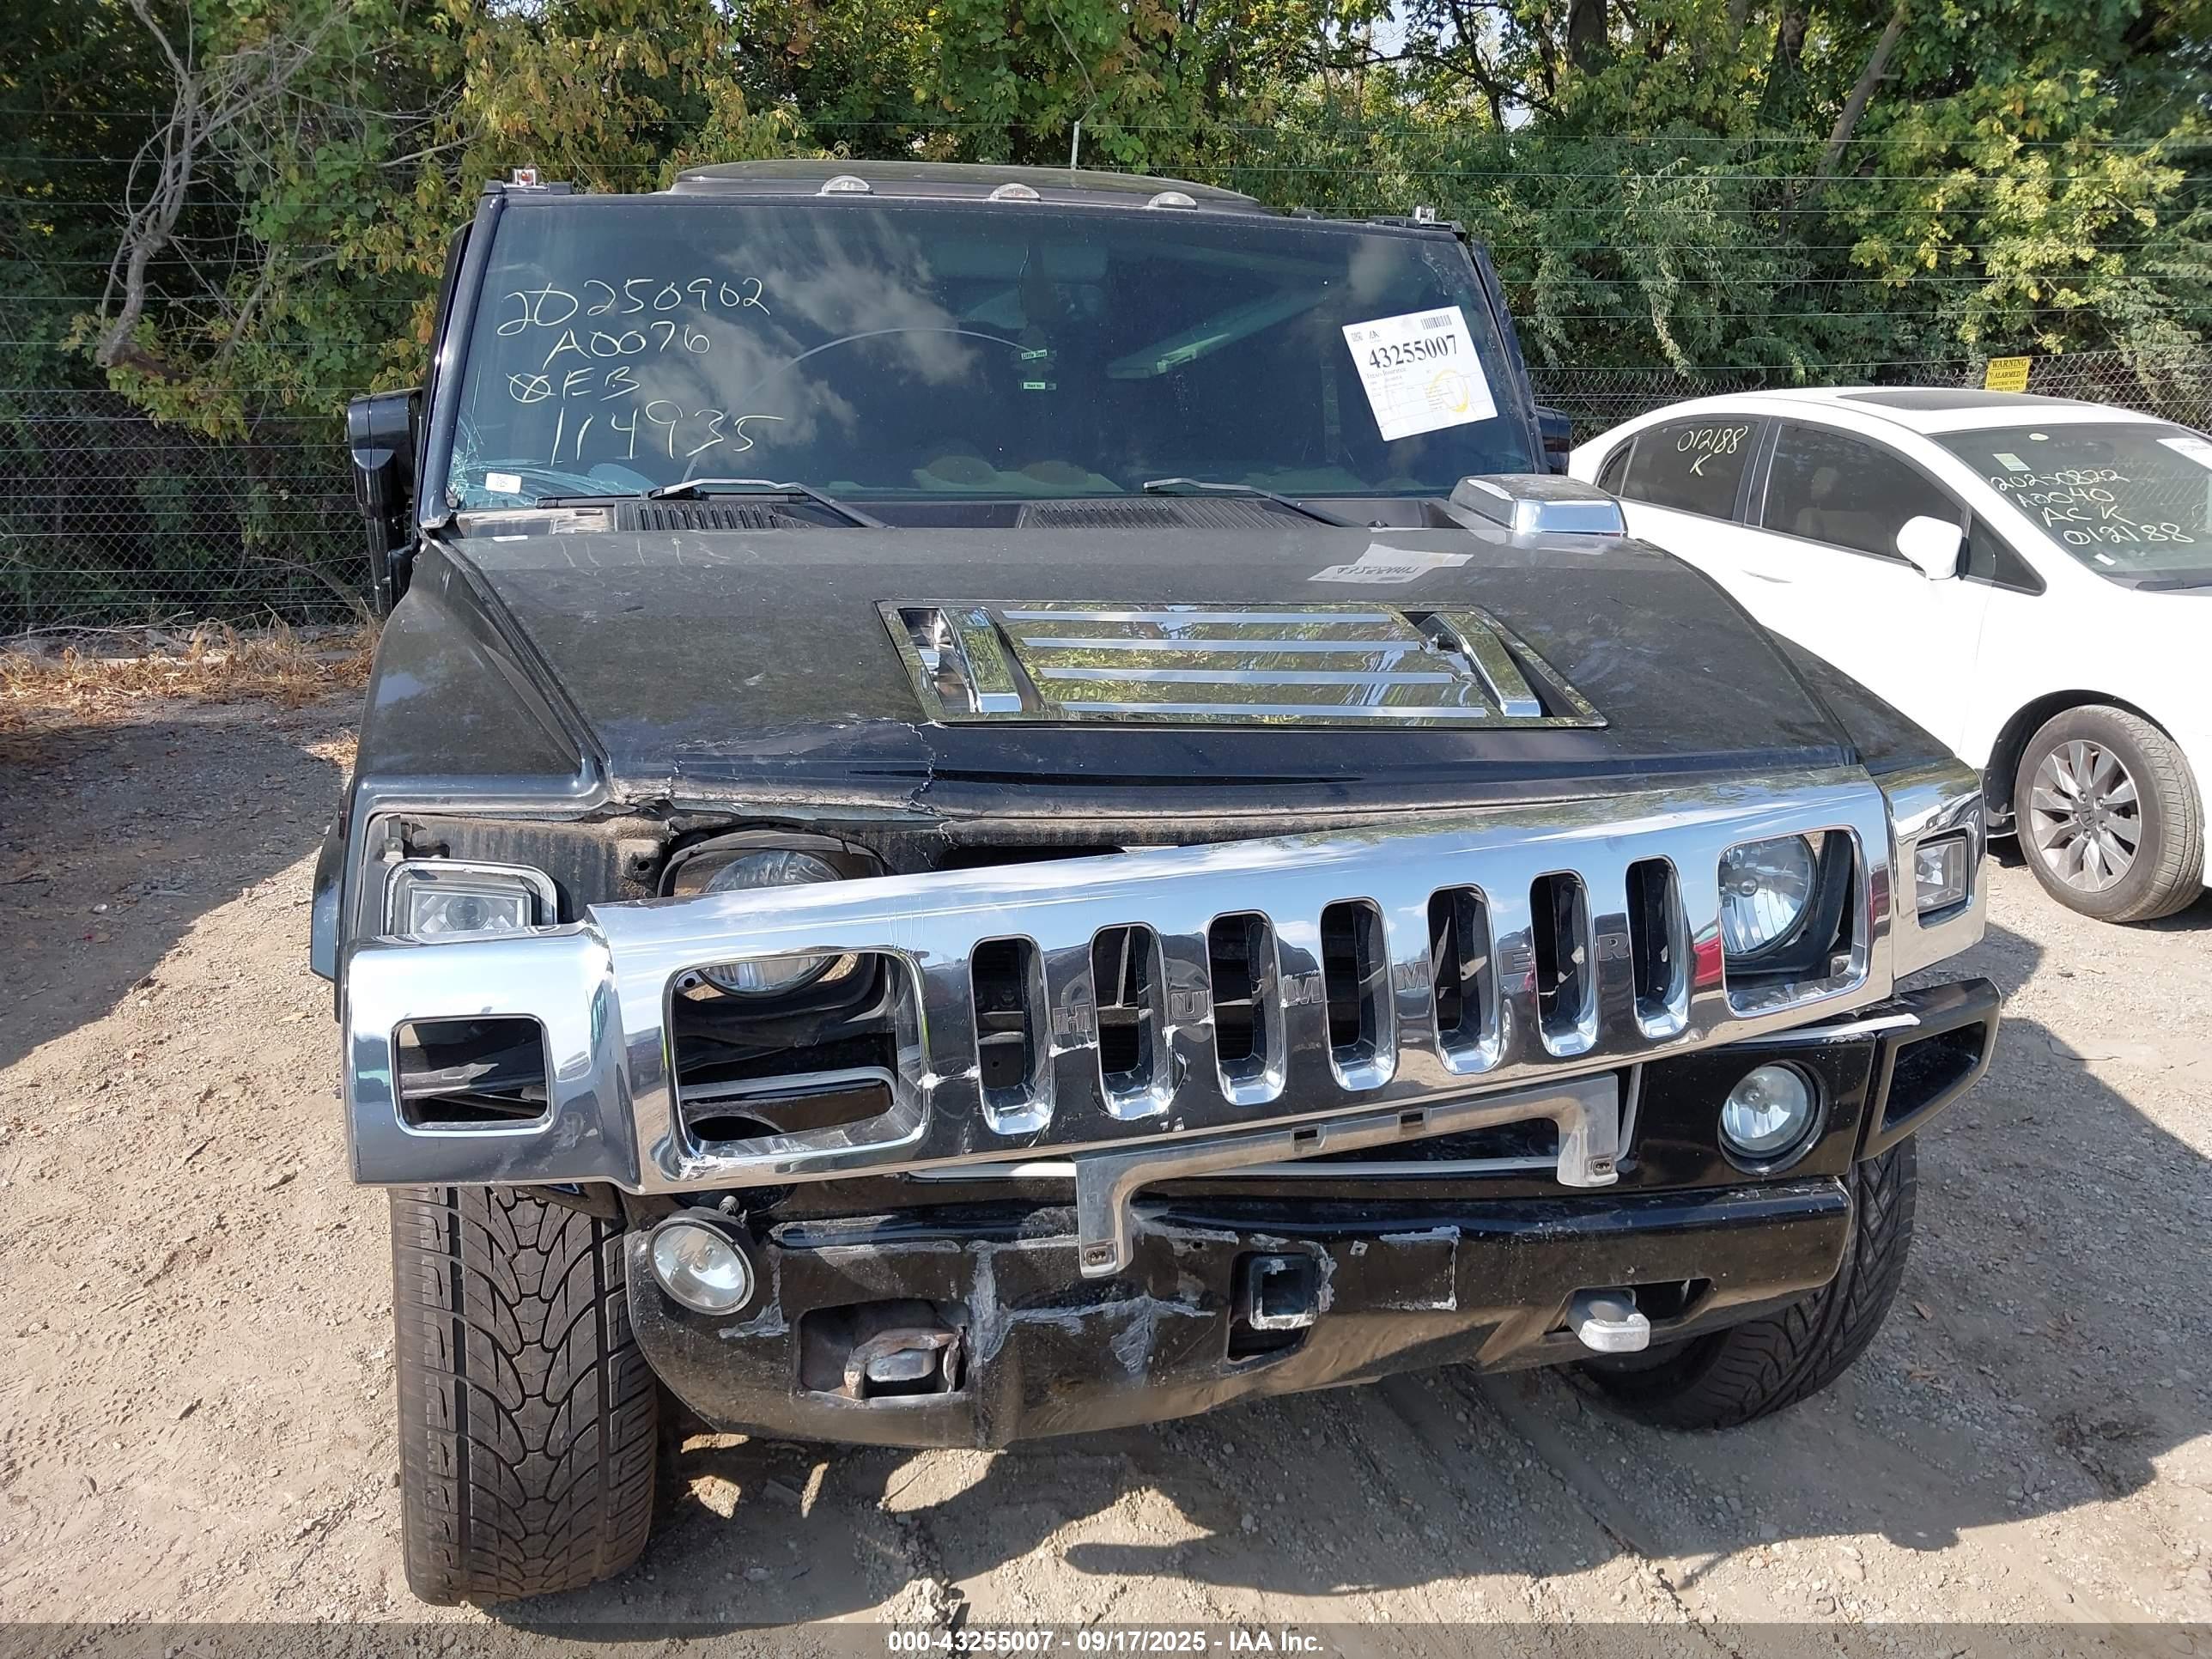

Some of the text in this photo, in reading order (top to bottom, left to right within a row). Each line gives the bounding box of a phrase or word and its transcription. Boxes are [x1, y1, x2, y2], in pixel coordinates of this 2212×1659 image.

[543, 320, 710, 371] A0076
[1369, 334, 1457, 369] 43255007
[1991, 358, 2027, 368] WARNING
[1993, 370, 2021, 379] ALARMED
[550, 400, 785, 467] 114935
[1677, 425, 1748, 454] 012188
[1689, 453, 1711, 477] K
[2063, 522, 2196, 546] 012188
